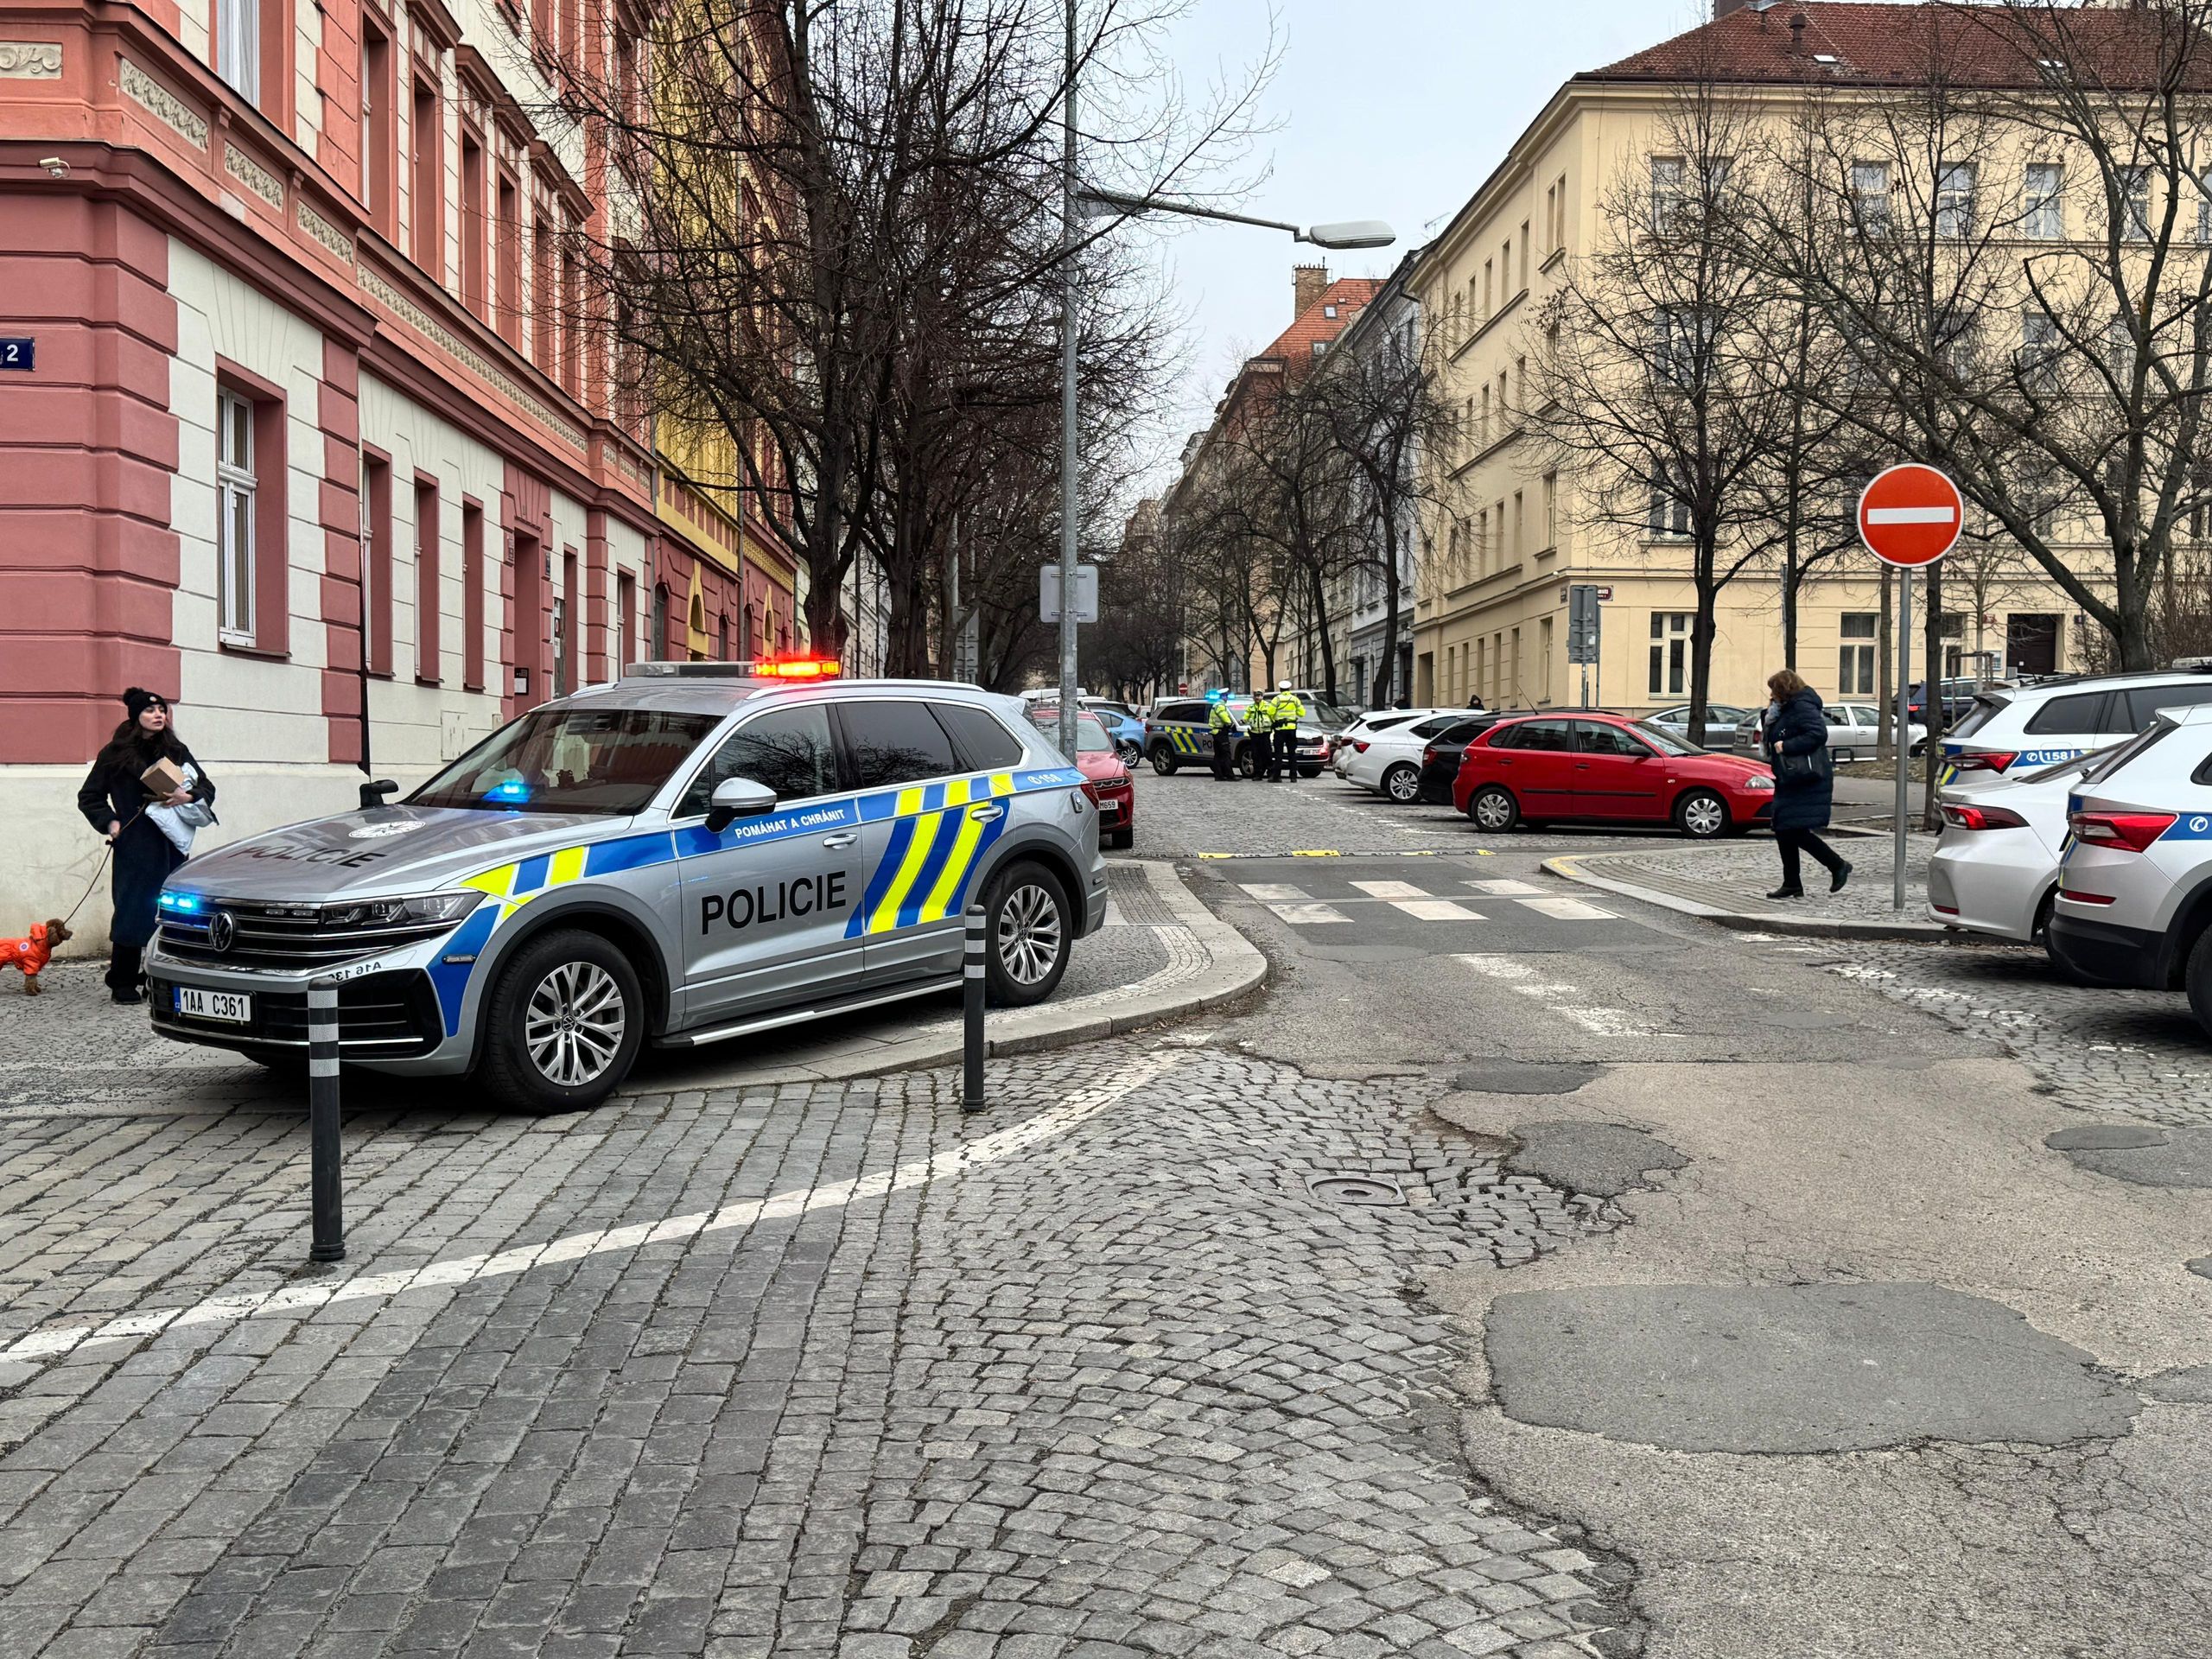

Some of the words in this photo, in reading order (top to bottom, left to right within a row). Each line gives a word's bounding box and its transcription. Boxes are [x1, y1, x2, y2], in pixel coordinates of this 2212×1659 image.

[7, 344, 19, 361] 2
[1203, 740, 1212, 748] PO
[2044, 752, 2068, 760] 158
[1039, 773, 1063, 783] 158
[1100, 800, 1116, 809] M659
[734, 821, 787, 838] POMÁHAT
[791, 818, 799, 828] A
[800, 810, 845, 826] CHRÁNIT
[228, 846, 387, 868] POLICIE
[702, 871, 847, 935] POLICIE
[183, 990, 204, 1013] 1AA
[213, 995, 244, 1018] C361
